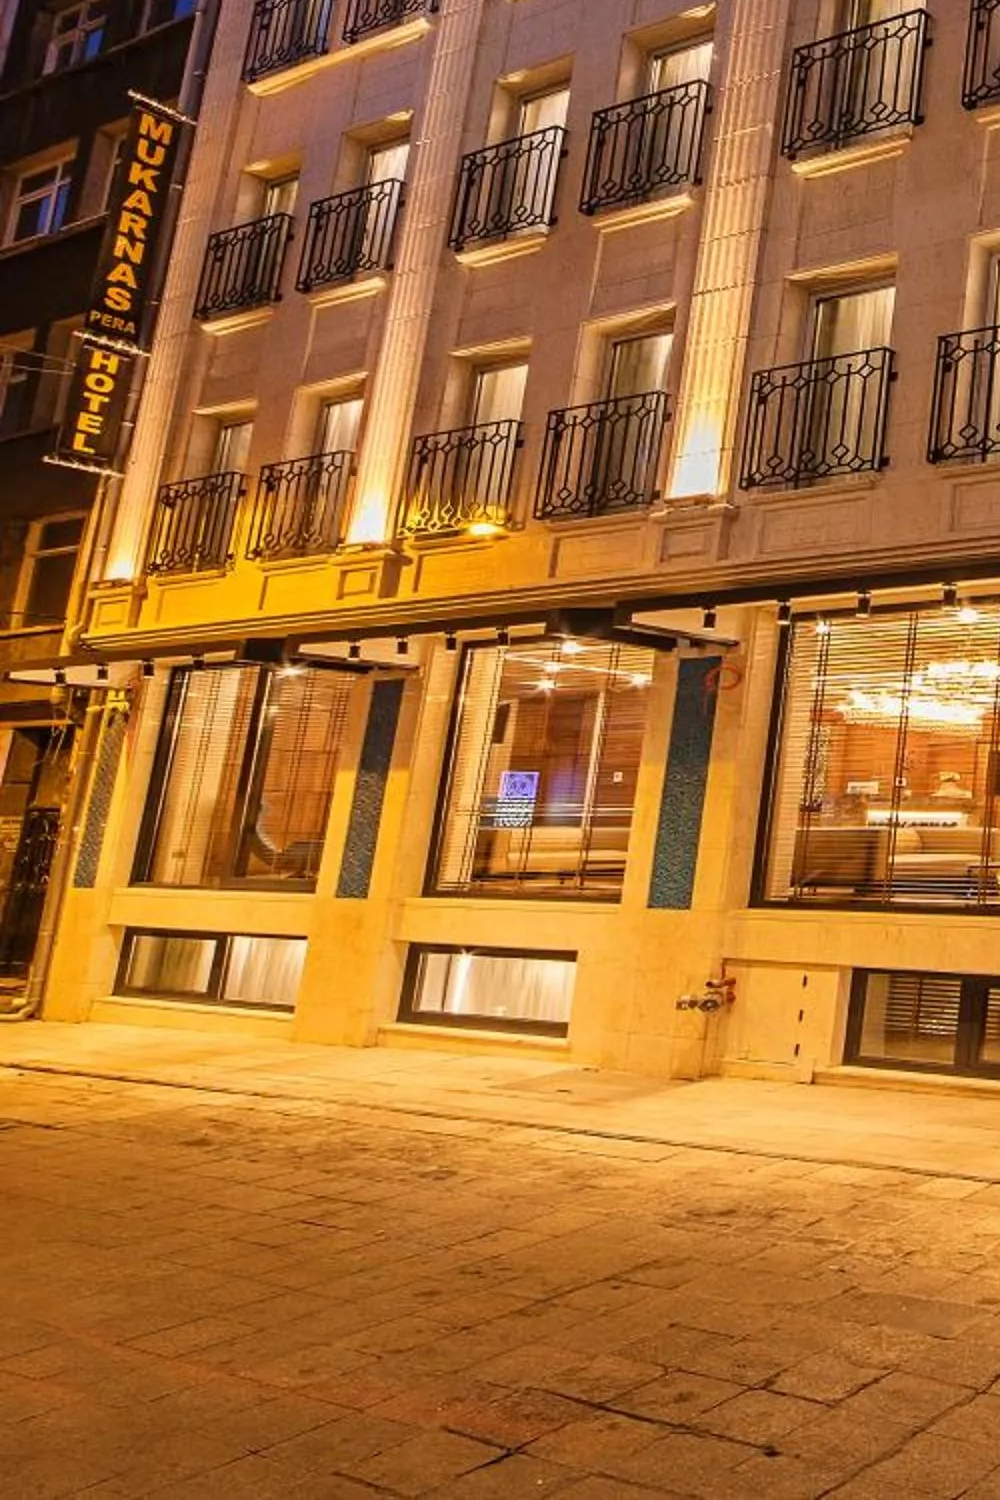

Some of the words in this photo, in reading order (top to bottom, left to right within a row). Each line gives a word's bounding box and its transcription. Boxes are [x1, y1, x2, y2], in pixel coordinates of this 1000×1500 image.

[103, 113, 173, 312] MUKARNAS
[89, 309, 137, 335] PERA
[72, 349, 120, 455] HOTEL
